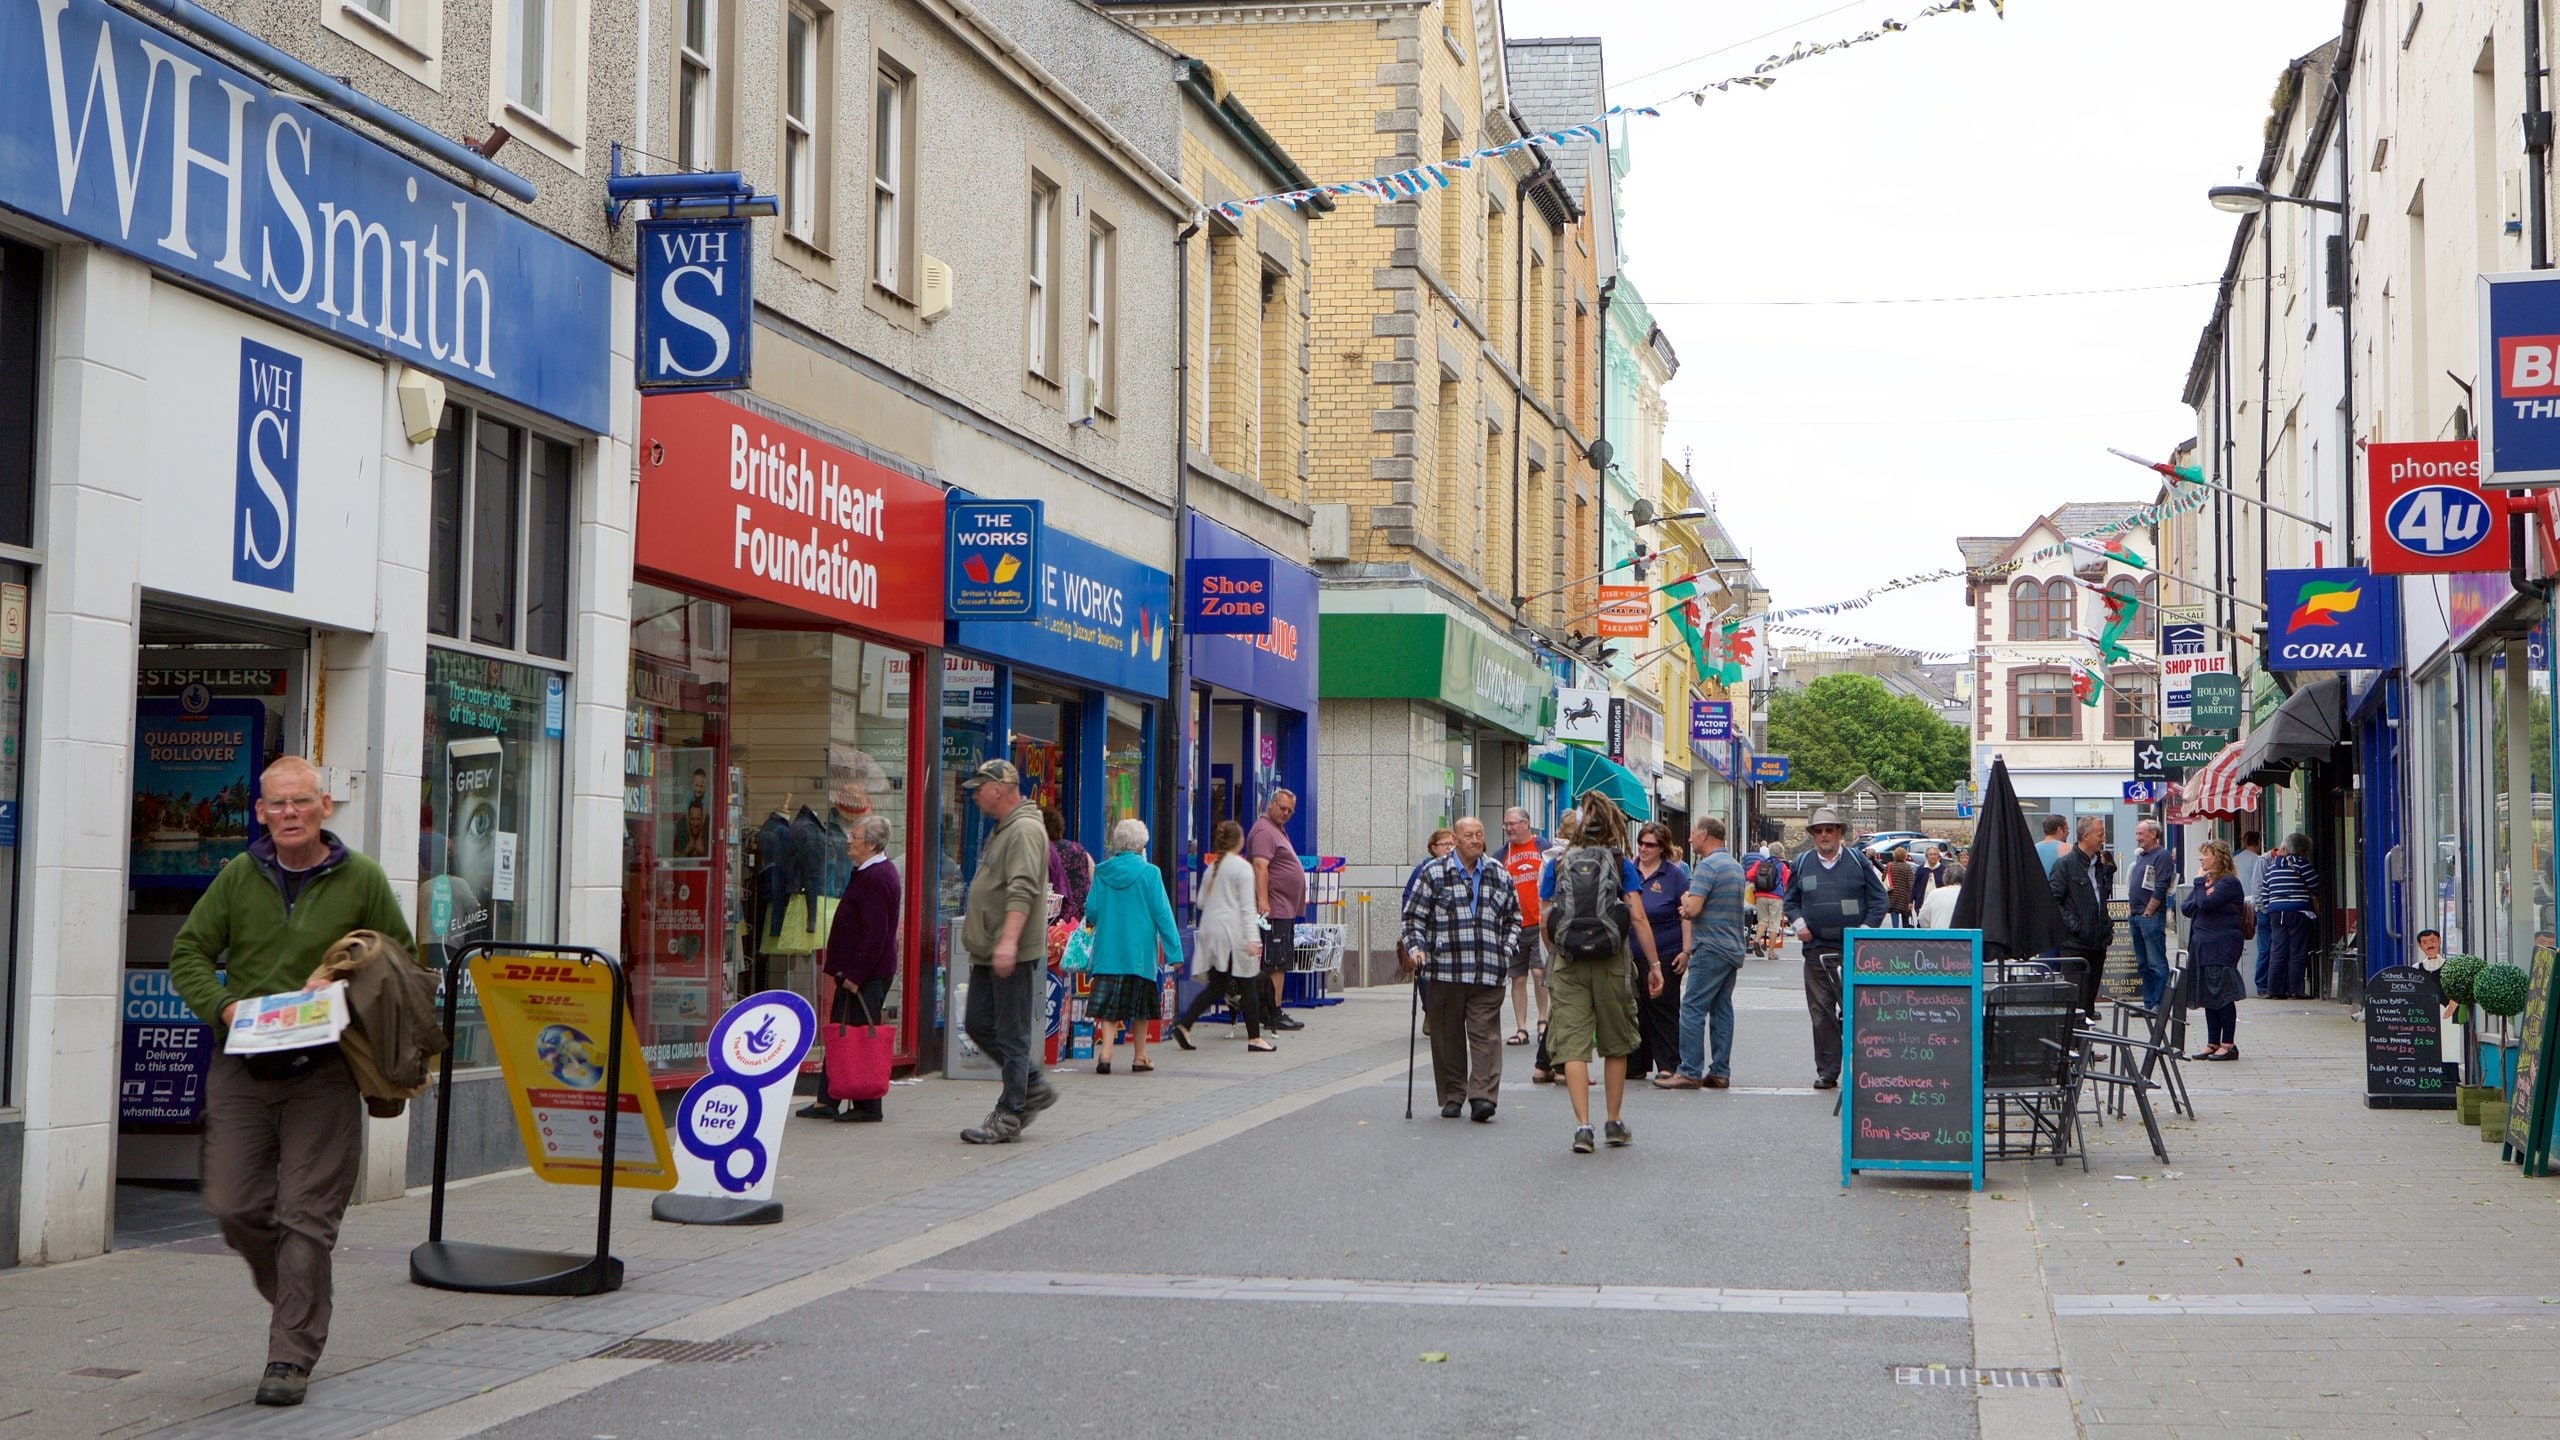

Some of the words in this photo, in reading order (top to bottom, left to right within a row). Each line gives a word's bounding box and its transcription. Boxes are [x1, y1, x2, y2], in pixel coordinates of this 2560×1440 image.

[37, 0, 496, 379] WHSmith
[658, 232, 728, 264] WH
[659, 265, 730, 377] S
[249, 358, 293, 413] WH
[2392, 457, 2480, 484] phones
[243, 409, 290, 570] S
[730, 423, 814, 514] British
[821, 460, 884, 542] Heart
[974, 514, 1012, 528] THE
[2399, 491, 2482, 551] 4u
[958, 532, 1028, 546] WORKS
[734, 503, 878, 610] Foundation
[1202, 576, 1263, 594] Shoe
[994, 590, 1021, 598] Leading
[1063, 570, 1122, 628] WORKS
[1602, 590, 1618, 598] FISH
[1201, 598, 1265, 615] Zone
[1602, 624, 1643, 632] TAKEAWAY
[2282, 644, 2367, 660] CORAL
[2165, 659, 2192, 674] SHOP
[2194, 658, 2206, 672] TO
[2210, 657, 2225, 671] LET
[137, 670, 272, 685] ESTSELLERS
[1476, 655, 1506, 706] LLOYDS
[1506, 670, 1527, 714] BANK
[449, 680, 466, 701] The
[467, 686, 491, 706] other
[493, 691, 511, 711] side
[2197, 688, 2235, 697] HOLLAND
[2212, 696, 2220, 705] &
[450, 704, 461, 722] of
[462, 706, 476, 726] the
[2197, 706, 2234, 715] BARRETT
[144, 732, 243, 746] QUADRUPLE
[2182, 741, 2203, 750] DRY
[150, 747, 235, 761] ROLLOVER
[456, 768, 493, 792] GREY
[1757, 768, 1784, 776] Factory
[503, 964, 582, 984] DHL
[527, 994, 576, 1006] DHL
[138, 1028, 201, 1048] FREE
[732, 1037, 741, 1049] The
[145, 1050, 187, 1062] Delivery
[734, 1051, 762, 1066] National
[763, 1039, 786, 1063] Lottery
[135, 1063, 145, 1072] to
[148, 1062, 166, 1072] this
[169, 1063, 194, 1072] store
[123, 1107, 191, 1118] whsmith.co.uk
[705, 1101, 738, 1117] Play
[700, 1115, 735, 1129] here
